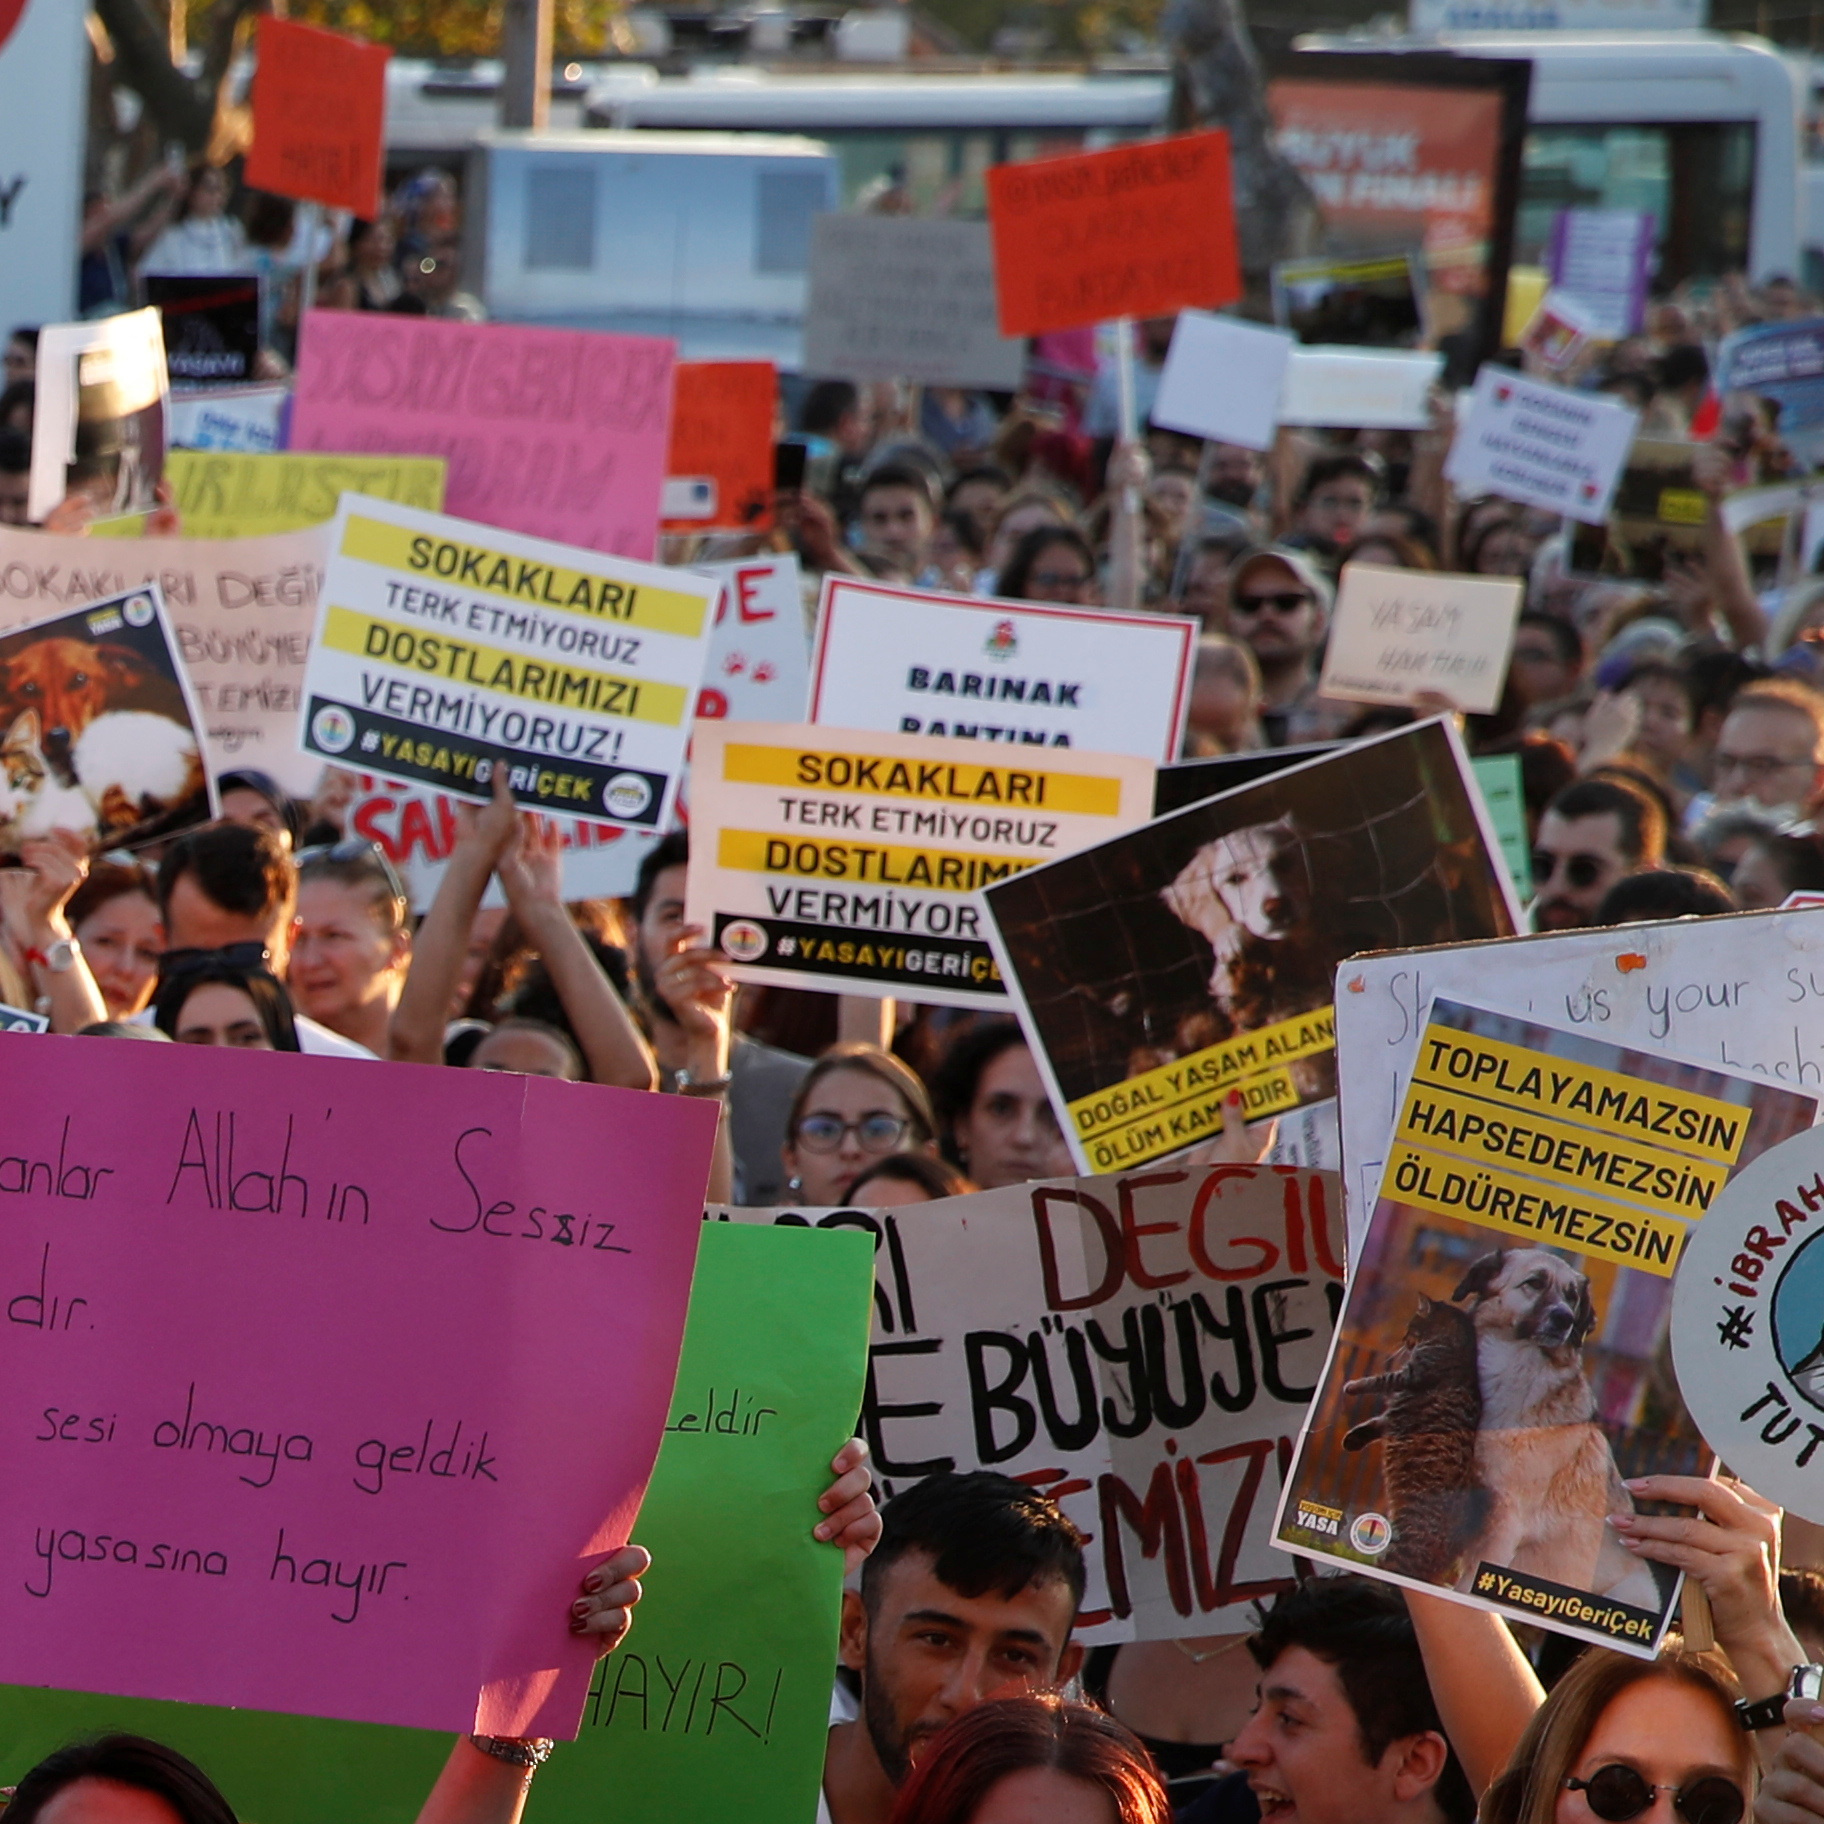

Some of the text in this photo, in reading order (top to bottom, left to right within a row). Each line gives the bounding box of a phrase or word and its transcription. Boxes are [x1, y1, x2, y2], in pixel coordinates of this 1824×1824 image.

[410, 536, 636, 620] SOKAKLARI
[386, 582, 642, 666] TERK ETMİYORUZ
[364, 623, 641, 717] DOSTLARIMIZI
[907, 665, 1083, 708] BARINAK
[361, 673, 625, 762] VERMİYORUZ!
[797, 755, 1046, 805] SOKAKLARI
[779, 798, 1058, 847] TERK ETMİYORUZ
[767, 886, 980, 938] VERMİYOR
[1565, 981, 1751, 1040] us your
[1076, 1041, 1260, 1131] DOĞAL YAŞAM
[1427, 1036, 1739, 1153] TOPLAYAMAZSIN
[165, 1106, 370, 1226] Allah'ın
[1093, 1124, 1166, 1170] ÖLÜM
[1406, 1099, 1716, 1211] HAPSEDEMEZSİN
[1394, 1152, 1676, 1265] ÖLDÜREMEZSİN
[36, 1409, 117, 1443] sesi
[153, 1382, 314, 1488] olmaya
[354, 1418, 501, 1495] geldik
[1297, 1510, 1340, 1536] YASA
[25, 1522, 228, 1597] yasasına
[272, 1528, 412, 1624] hayır.
[1476, 1569, 1655, 1641] #YasayıGeriÇek
